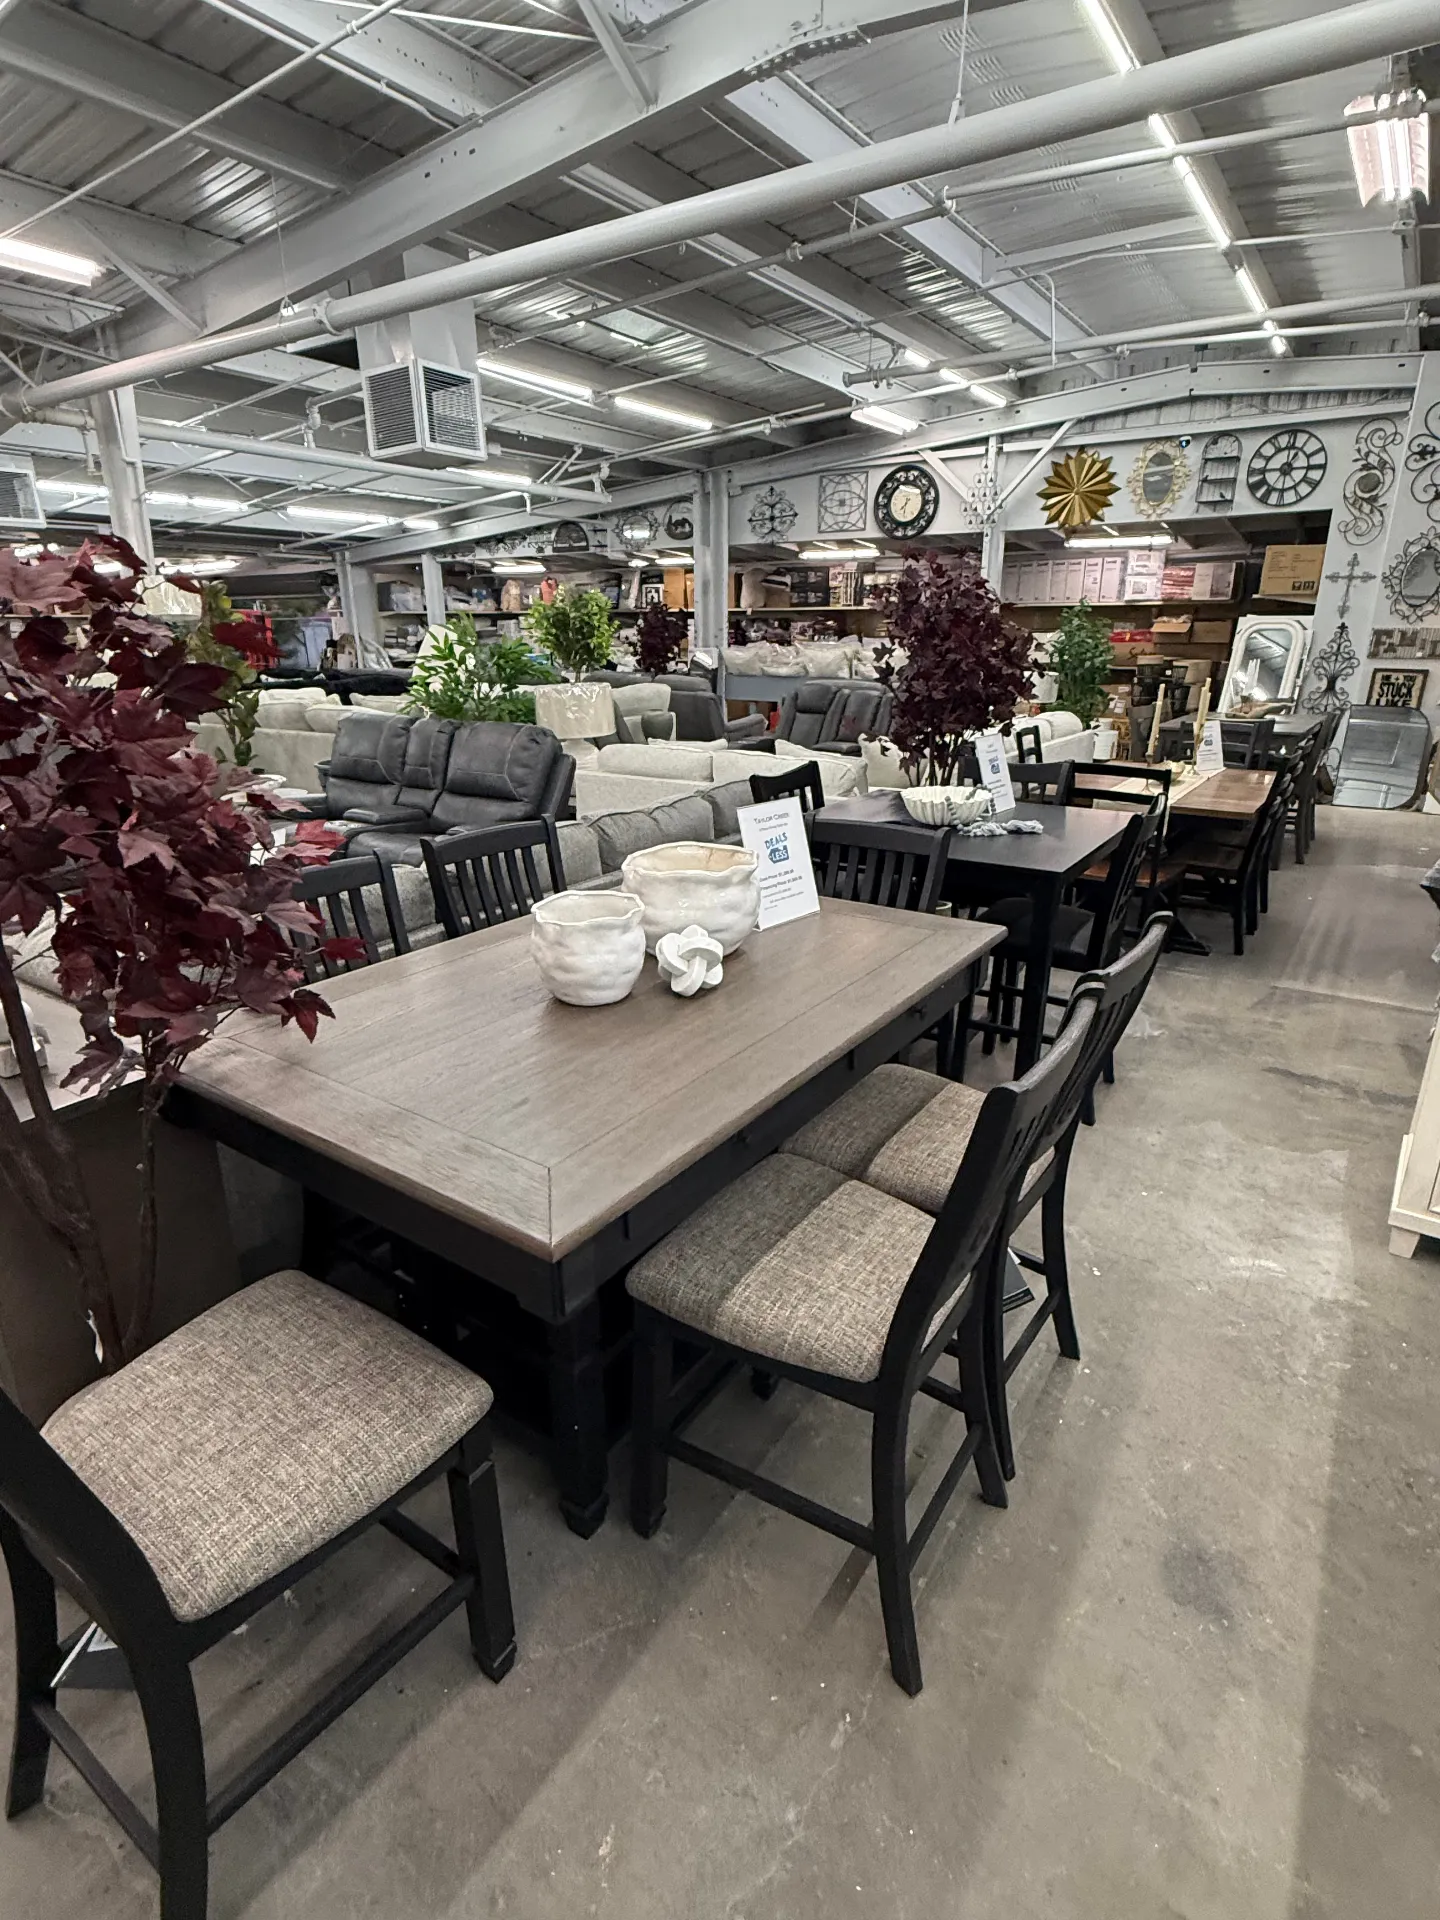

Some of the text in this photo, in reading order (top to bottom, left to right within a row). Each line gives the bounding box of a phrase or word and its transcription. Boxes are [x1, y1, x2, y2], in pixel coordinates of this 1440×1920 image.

[1378, 682, 1416, 698] STUCK
[754, 815, 773, 824] TAYLOR
[764, 832, 788, 850] DEALS
[771, 850, 788, 861] LESS
